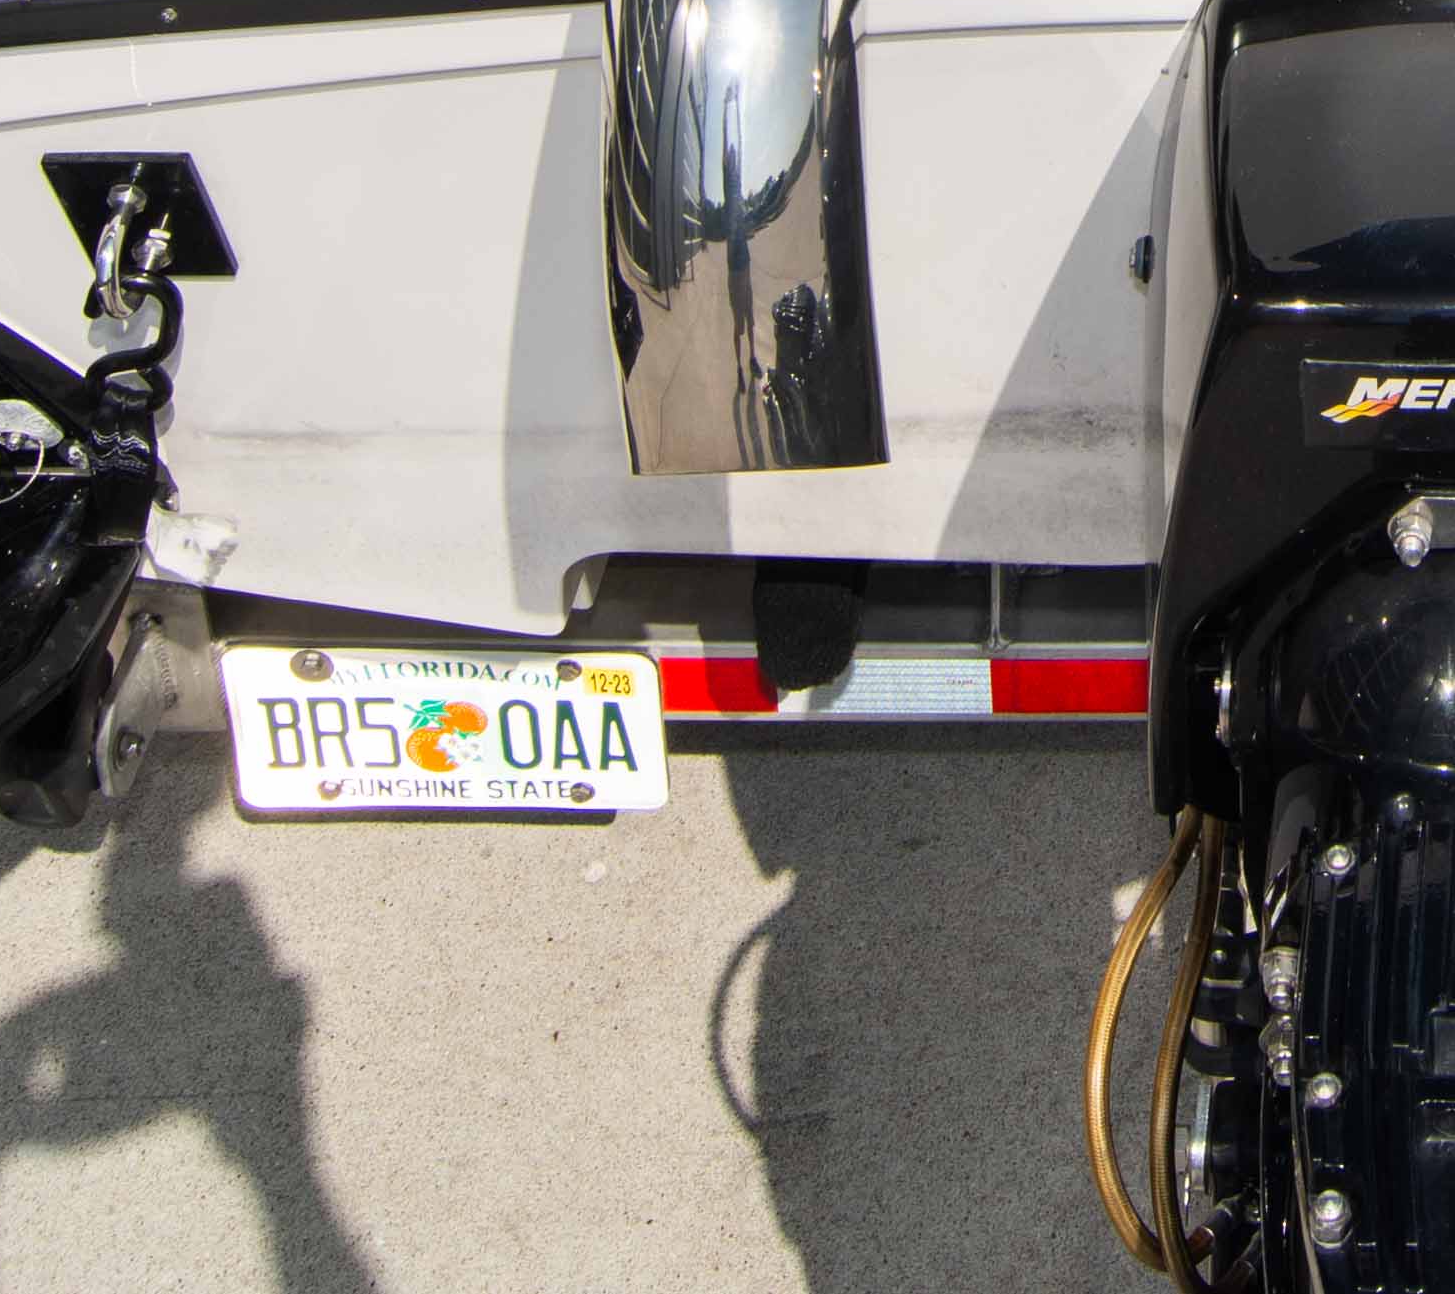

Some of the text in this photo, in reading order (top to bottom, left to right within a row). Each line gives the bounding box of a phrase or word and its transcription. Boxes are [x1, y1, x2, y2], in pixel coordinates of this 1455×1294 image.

[590, 672, 632, 697] 12-23
[256, 697, 402, 769] BR5
[342, 778, 571, 800] SUNSHINE STATE
